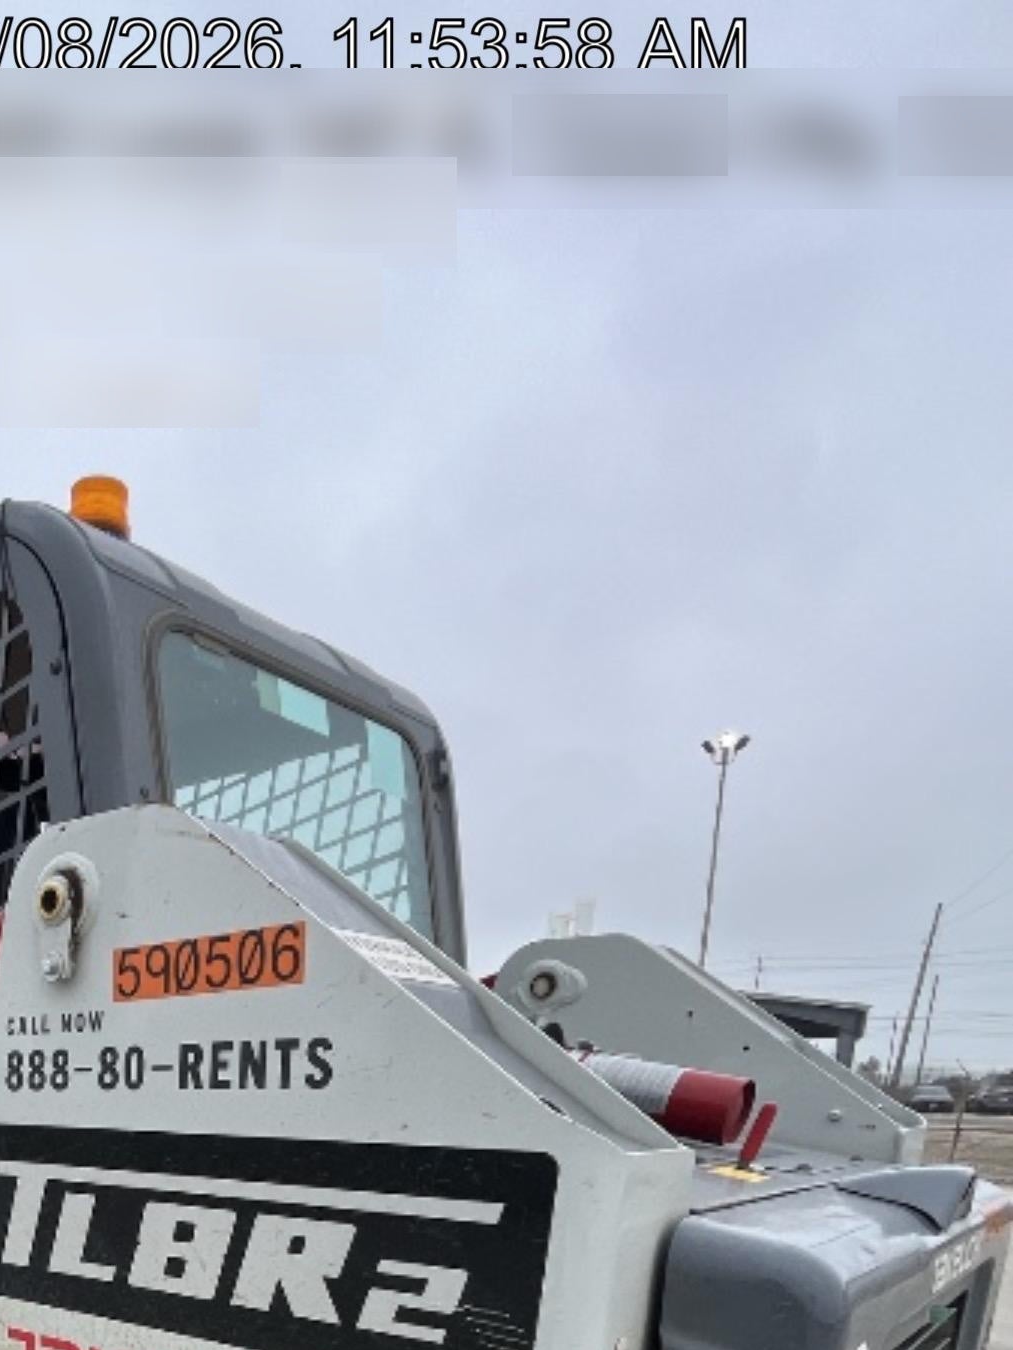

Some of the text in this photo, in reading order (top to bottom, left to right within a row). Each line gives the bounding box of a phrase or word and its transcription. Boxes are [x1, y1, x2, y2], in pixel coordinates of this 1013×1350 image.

[117, 924, 302, 999] 590506
[7, 1010, 105, 1036] CALL NOW
[5, 1037, 334, 1092] 888-80-RENTS
